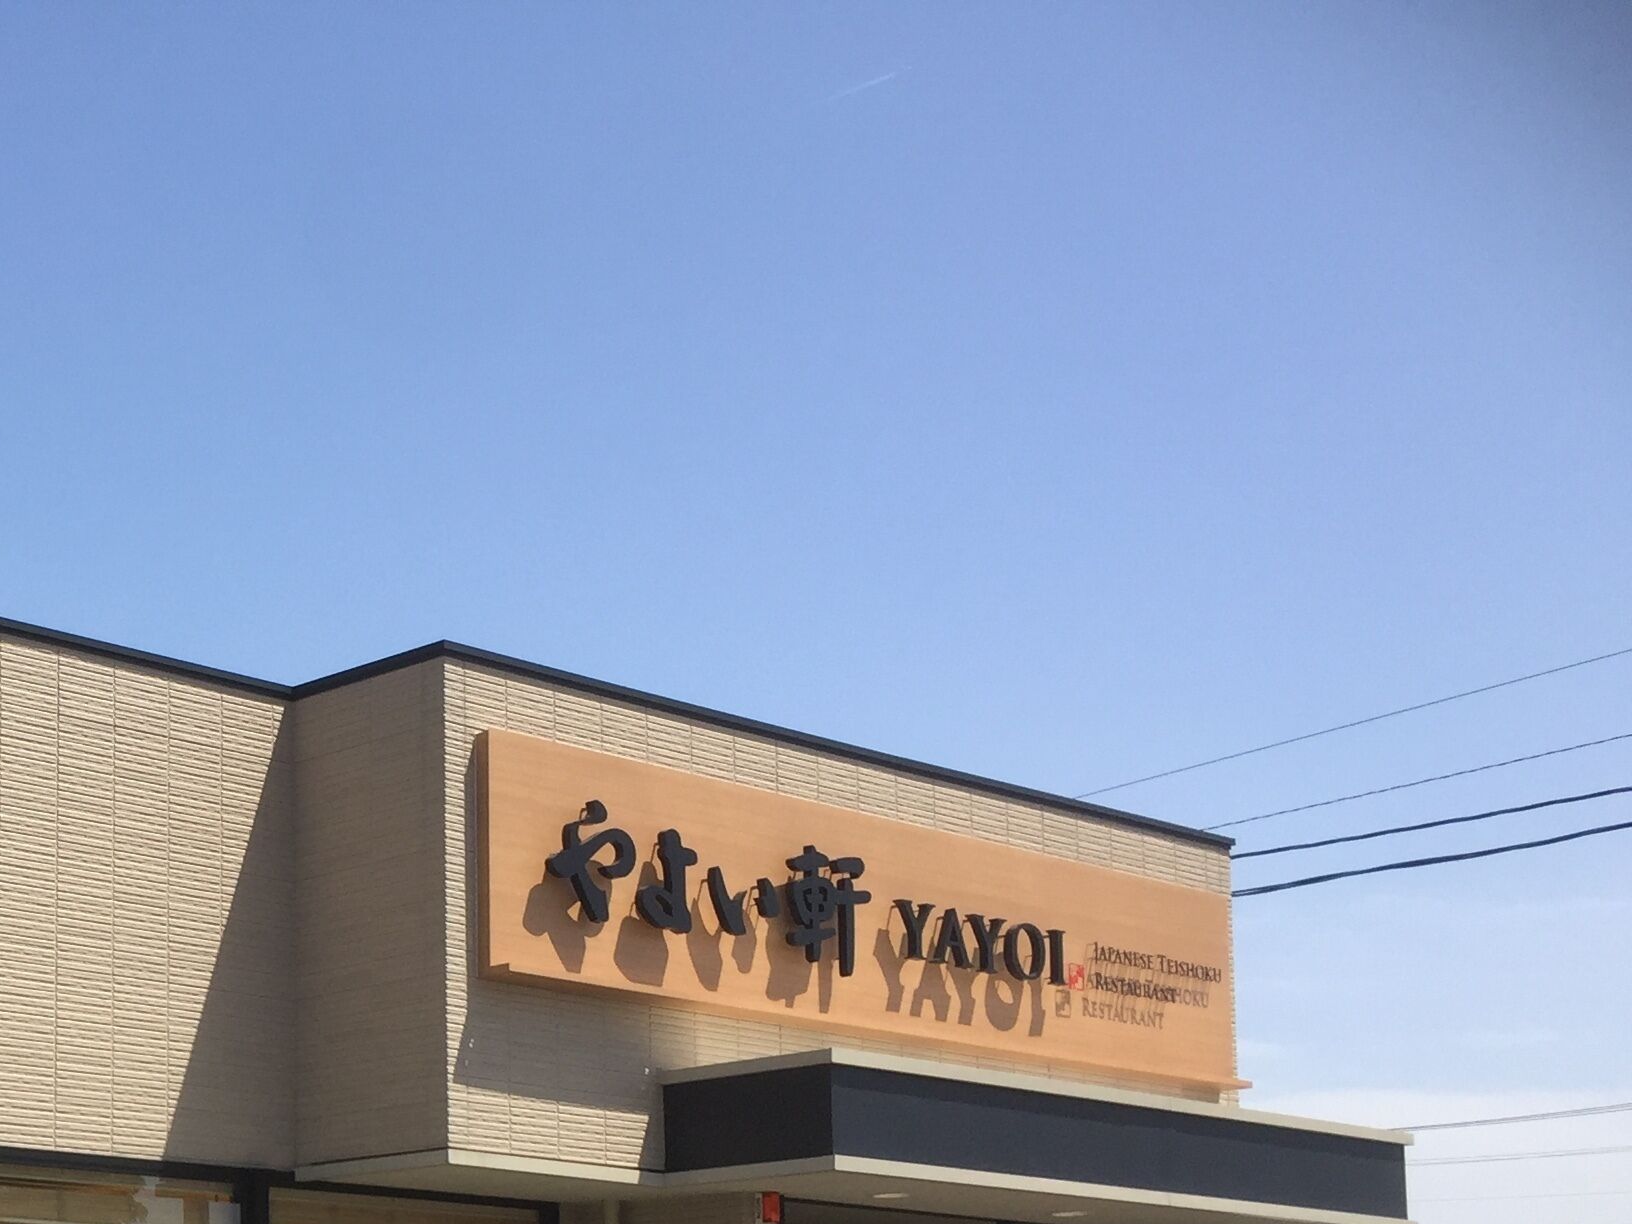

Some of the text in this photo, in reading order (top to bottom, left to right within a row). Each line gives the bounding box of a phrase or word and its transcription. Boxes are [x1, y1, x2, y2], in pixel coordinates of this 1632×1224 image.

[545, 800, 872, 977] やよい軒
[893, 899, 1066, 986] YAYOI
[1094, 942, 1222, 983] JAPANESE TEISHOKU
[1095, 972, 1176, 1003] RESTAURANT
